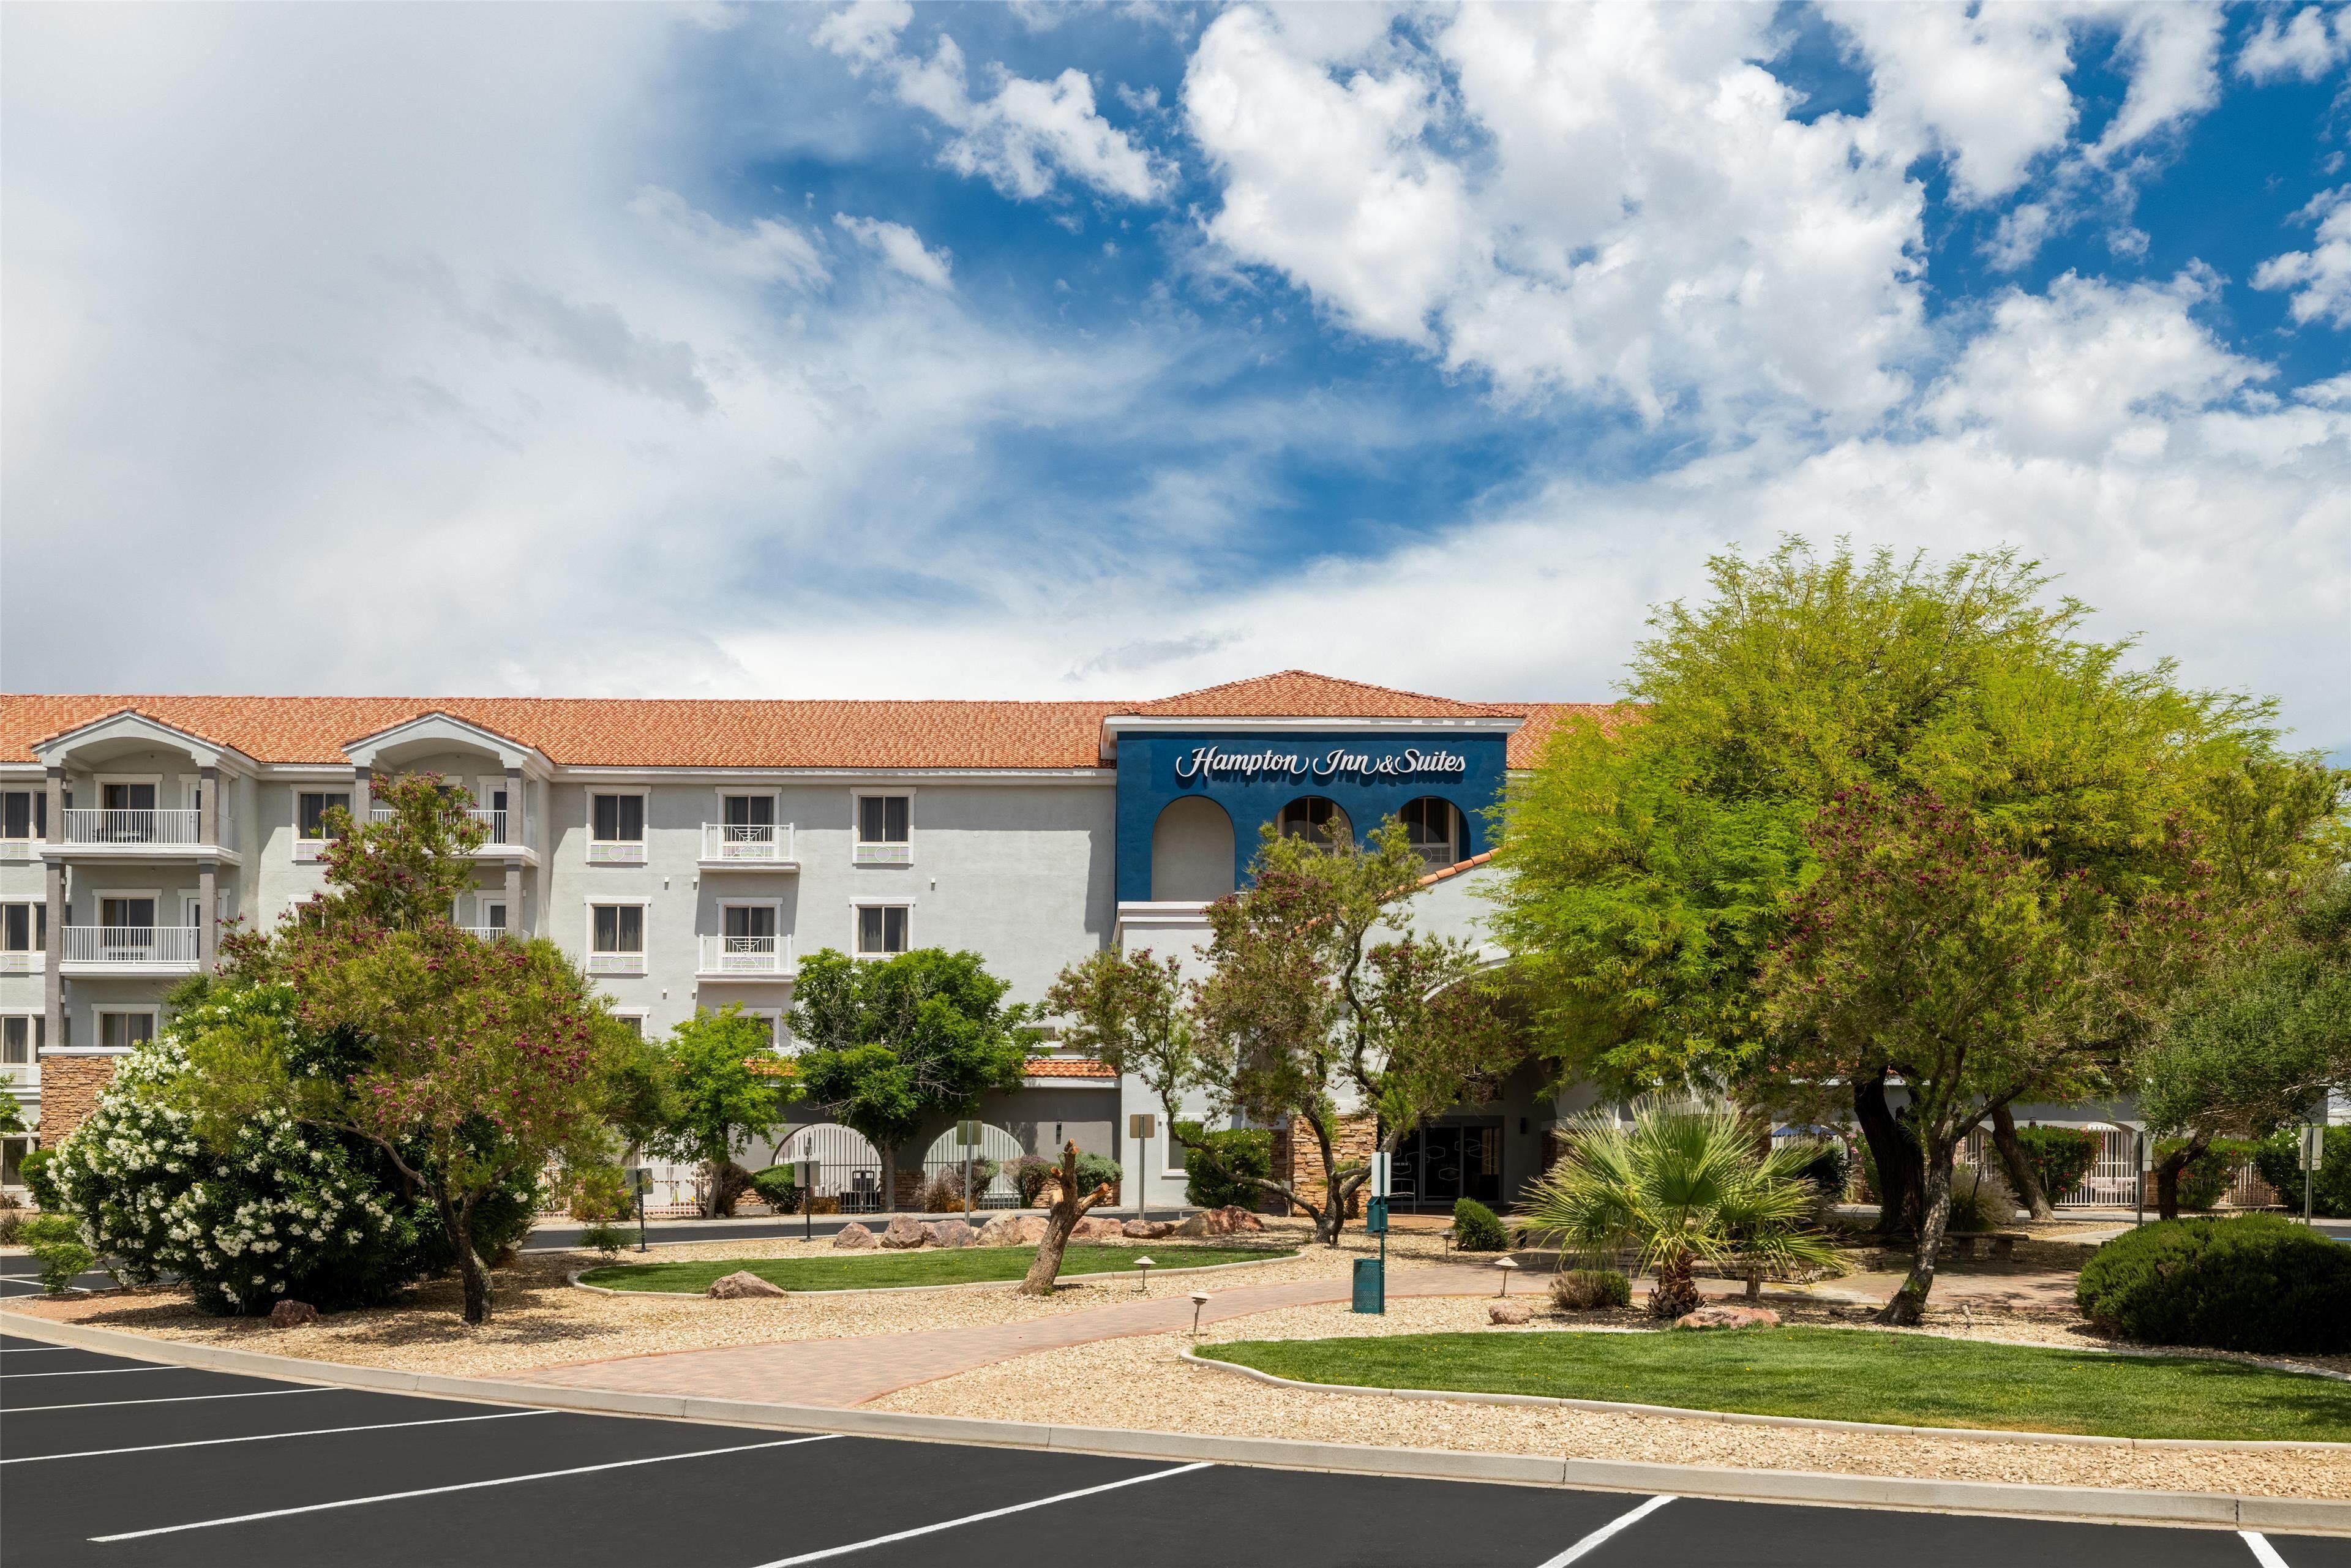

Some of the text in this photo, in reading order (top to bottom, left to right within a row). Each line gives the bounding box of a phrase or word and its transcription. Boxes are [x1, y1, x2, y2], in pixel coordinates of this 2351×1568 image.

[1176, 746, 1309, 777] Hampton
[1312, 749, 1379, 775] Inn
[1394, 749, 1466, 773] Suites
